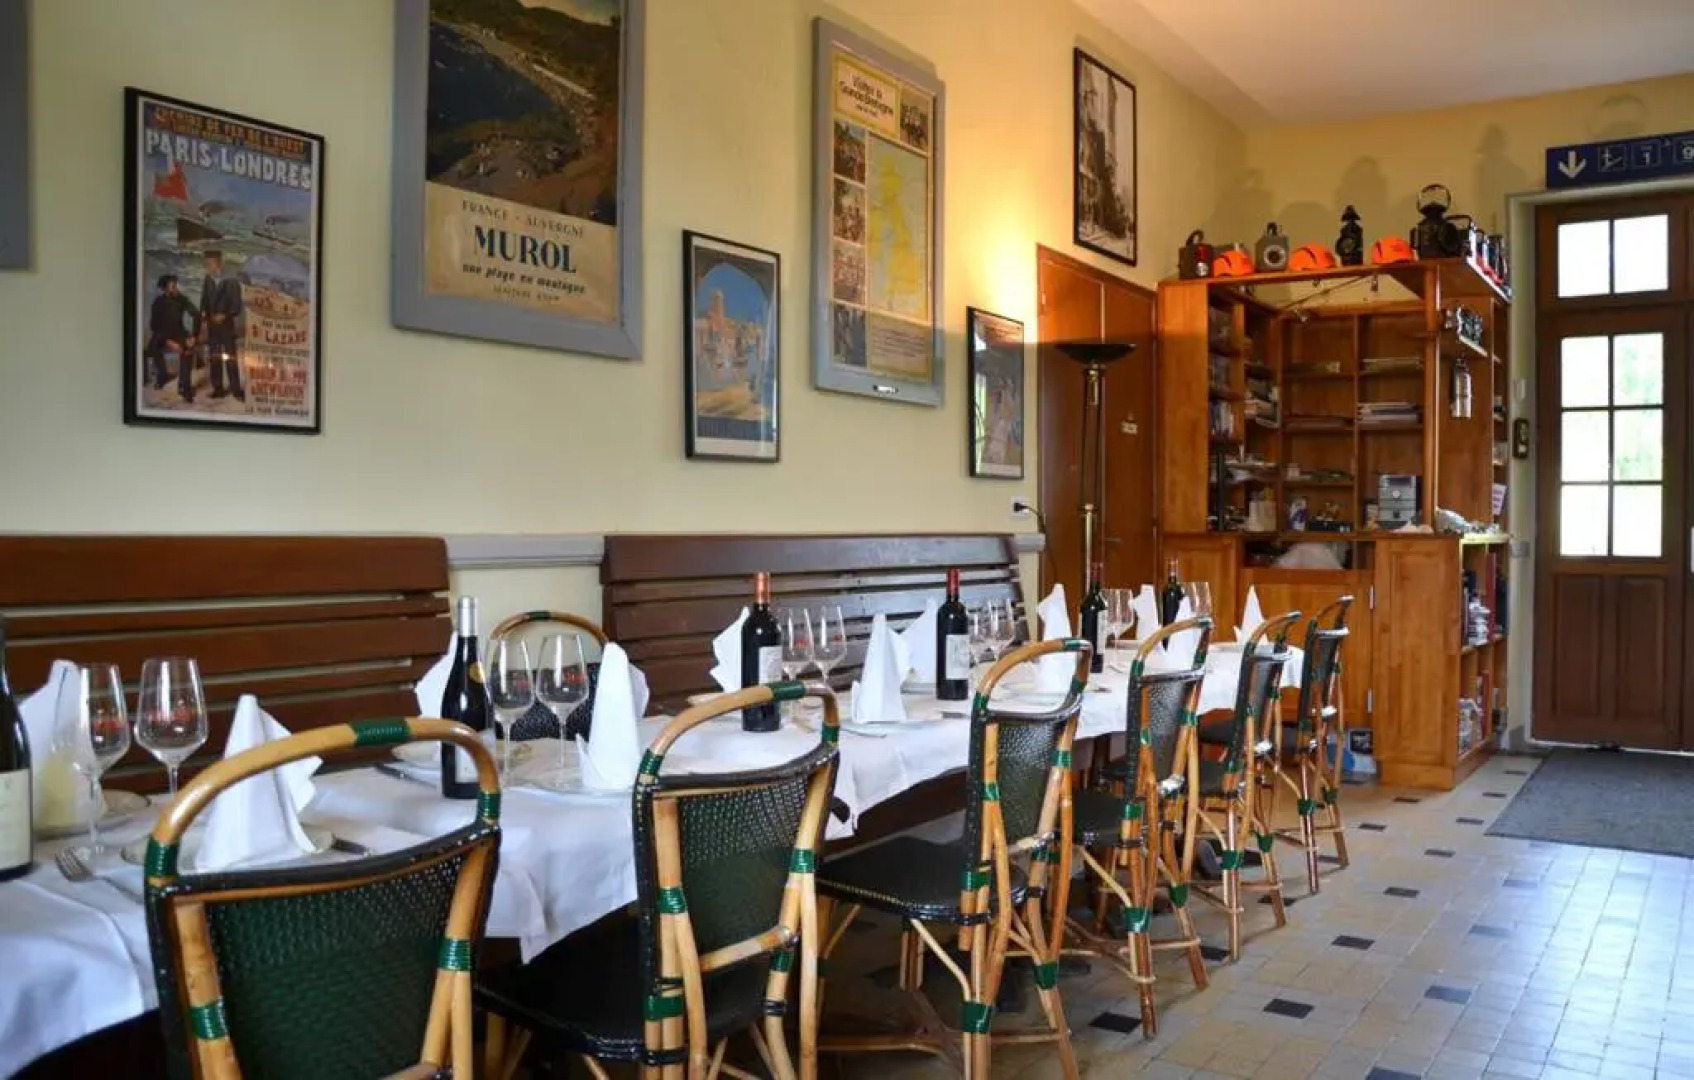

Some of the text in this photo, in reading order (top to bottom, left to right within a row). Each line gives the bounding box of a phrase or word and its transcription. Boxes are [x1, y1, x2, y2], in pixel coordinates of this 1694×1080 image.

[462, 200, 507, 220] FRANCE
[473, 224, 577, 274] MUROL
[462, 263, 482, 275] une
[485, 265, 515, 282] plage
